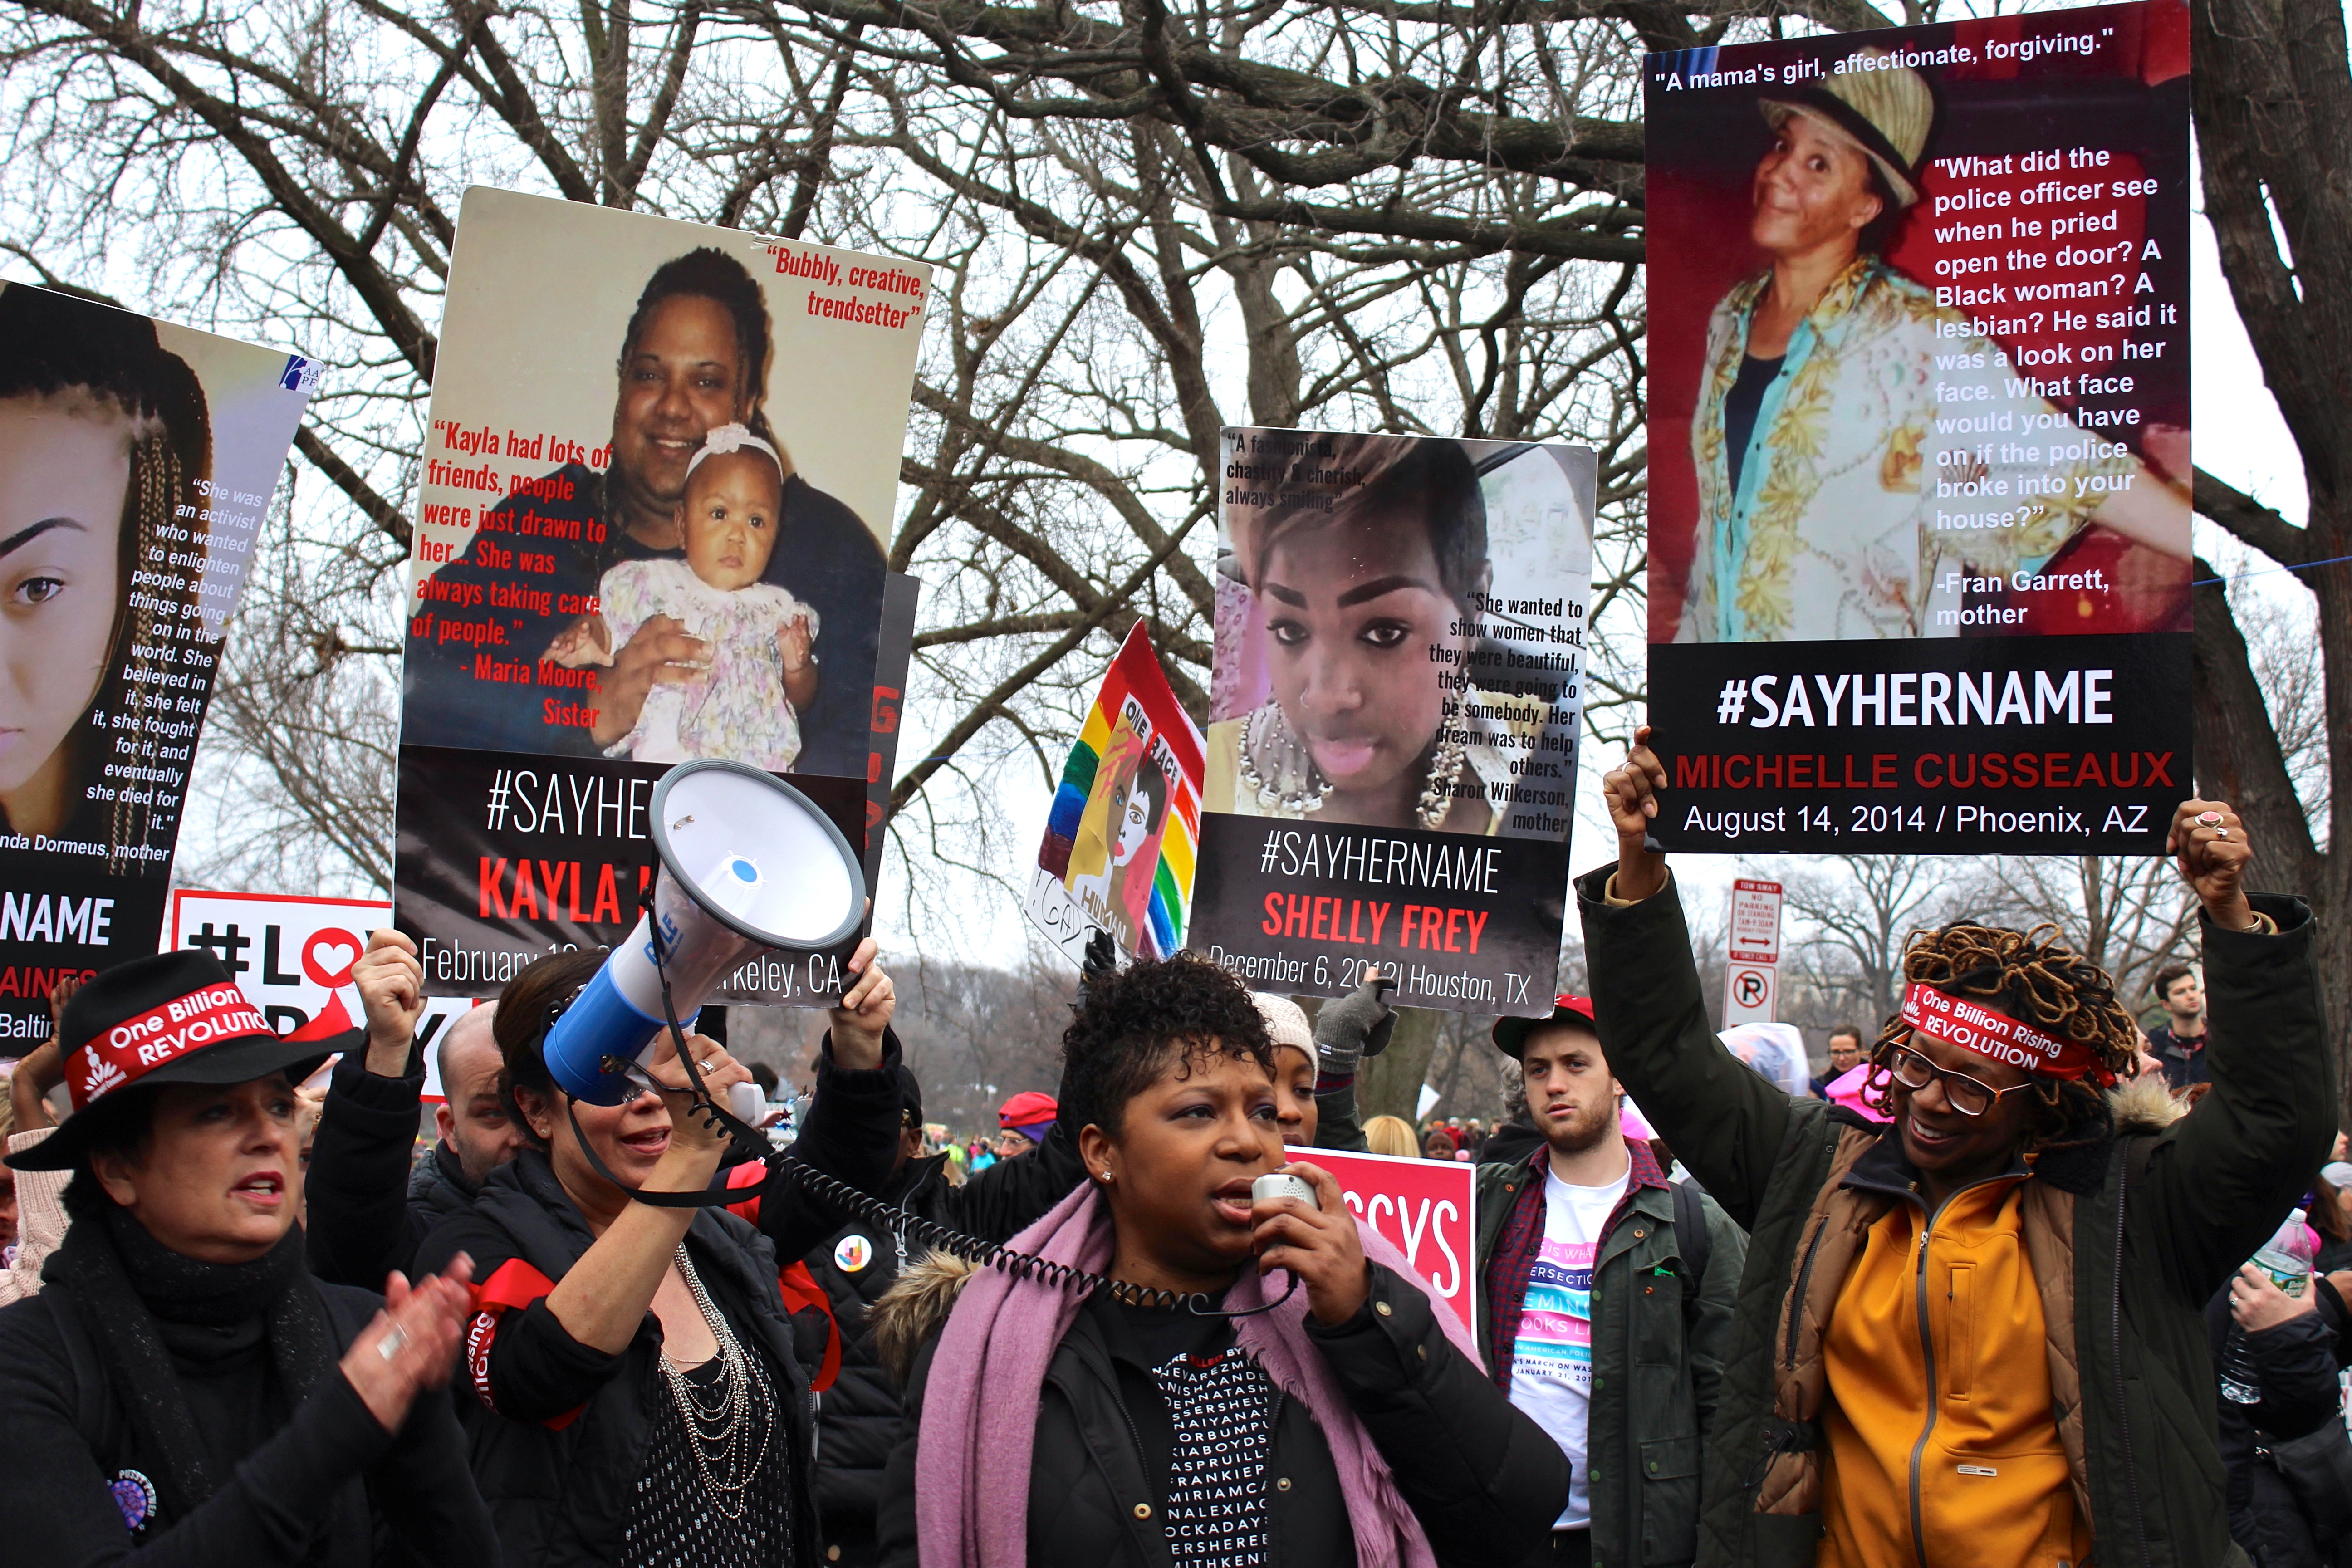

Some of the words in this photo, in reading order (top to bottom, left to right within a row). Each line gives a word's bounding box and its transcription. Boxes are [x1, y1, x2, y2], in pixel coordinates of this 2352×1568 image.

[1655, 73, 1683, 92] "A
[1690, 64, 1775, 90] mama's
[1782, 58, 1826, 82] girl,
[1833, 44, 1978, 76] affectionate,
[1984, 27, 2114, 60] forgiving."
[1934, 154, 2012, 178] "What
[2020, 149, 2060, 173] did
[2068, 147, 2110, 168] the
[1935, 189, 2011, 217] police
[2019, 182, 2103, 204] officer
[2112, 178, 2158, 197] see
[1935, 222, 2001, 243] when
[2012, 217, 2042, 237] he
[2051, 210, 2117, 240] pried
[767, 245, 842, 287] “Bubbly,
[849, 266, 924, 300] creative,
[1936, 284, 2006, 307] Black
[2014, 274, 2125, 301] woman?
[2134, 273, 2154, 294] A
[808, 291, 920, 329] trendsetter”
[1936, 313, 2043, 338] lesbian?
[2053, 310, 2087, 332] He
[2095, 305, 2150, 328] said
[2160, 304, 2176, 324] it
[301, 376, 317, 386] PF
[304, 368, 318, 377] AA
[435, 420, 499, 455] “Kayla
[507, 431, 543, 459] had
[549, 436, 585, 465] lots
[591, 443, 612, 468] of
[1250, 435, 1336, 460] fashionista,
[428, 459, 503, 496] friends,
[509, 474, 573, 502] people
[1226, 461, 1285, 484] chastity
[1291, 467, 1301, 483] &
[1307, 467, 1366, 489] cherish,
[193, 479, 228, 500] “She
[233, 492, 262, 507] was
[1226, 485, 1274, 508] always
[1279, 492, 1343, 514] smiling”
[176, 503, 196, 517] an
[199, 507, 256, 530] activist
[156, 523, 188, 542] who
[193, 532, 248, 553] wanted
[131, 569, 185, 591] people
[189, 580, 234, 598] about
[417, 573, 483, 606] always
[490, 581, 552, 616] taking
[559, 594, 599, 616] care
[1936, 572, 2002, 593] -Fran
[2011, 569, 2109, 593] Garrett,
[129, 591, 178, 614] things
[182, 603, 226, 625] going
[1467, 592, 1503, 612] “She
[1508, 598, 1562, 617] wanted
[1568, 600, 1582, 618] to
[1936, 604, 2027, 625] mother
[132, 642, 178, 663] world.
[183, 649, 212, 667] She
[123, 665, 187, 689] believed
[191, 674, 206, 691] in
[543, 698, 599, 728] Sister
[1442, 697, 1458, 716] be
[1465, 699, 1543, 725] somebody.
[1548, 706, 1575, 725] Her
[1718, 669, 2114, 728] #SAYHERNAME
[1125, 701, 1147, 741] ONE
[1149, 737, 1180, 786] RACE
[105, 762, 184, 788] eventually
[1676, 753, 1898, 789] MICHELLE
[1914, 751, 2174, 789] CUSSEAUX
[87, 785, 115, 802] she
[119, 788, 152, 805] died
[157, 791, 178, 808] for
[1433, 777, 1485, 799] Sharon
[1491, 782, 1568, 810] Wilkerson,
[1513, 813, 1568, 833] mother
[1683, 804, 1786, 838] August
[1797, 805, 1840, 836] 14,
[1851, 805, 1926, 833] 2014
[1936, 805, 1945, 833] /
[1957, 805, 2090, 837] Phoenix,
[2102, 805, 2149, 833] AZ
[34, 835, 110, 859] Dormeus,
[115, 844, 169, 862] mother
[1260, 829, 1502, 894] #SAYHERNAME
[478, 856, 622, 924] KAYLA
[1740, 882, 1754, 890] TOW
[1757, 883, 1778, 892] AWAY
[1081, 884, 1126, 944] HUMAN
[1739, 902, 1774, 911] PARKING
[1747, 910, 1774, 919] STANDING
[642, 912, 679, 966] PLE
[1262, 892, 1391, 945] SHELLY
[1400, 905, 1489, 954] FREY
[716, 955, 800, 998] keley,
[808, 954, 842, 993] CA
[1314, 955, 1332, 988] 6,
[1409, 965, 1497, 1005] Houston,
[1504, 972, 1532, 1005] TX
[110, 1016, 164, 1049] One
[168, 989, 241, 1023] Billion
[1923, 990, 1950, 1012] One
[1954, 1002, 2009, 1036] Billion
[2012, 1025, 2063, 1058] Rising
[137, 1011, 276, 1066] REVOLUTIO
[1925, 1015, 2039, 1070] REVOLUTION
[1548, 1244, 1560, 1257] IS
[1565, 1247, 1596, 1260] WHA
[1525, 1345, 1566, 1355] AMERICAN
[1526, 1359, 1554, 1367] MARCH
